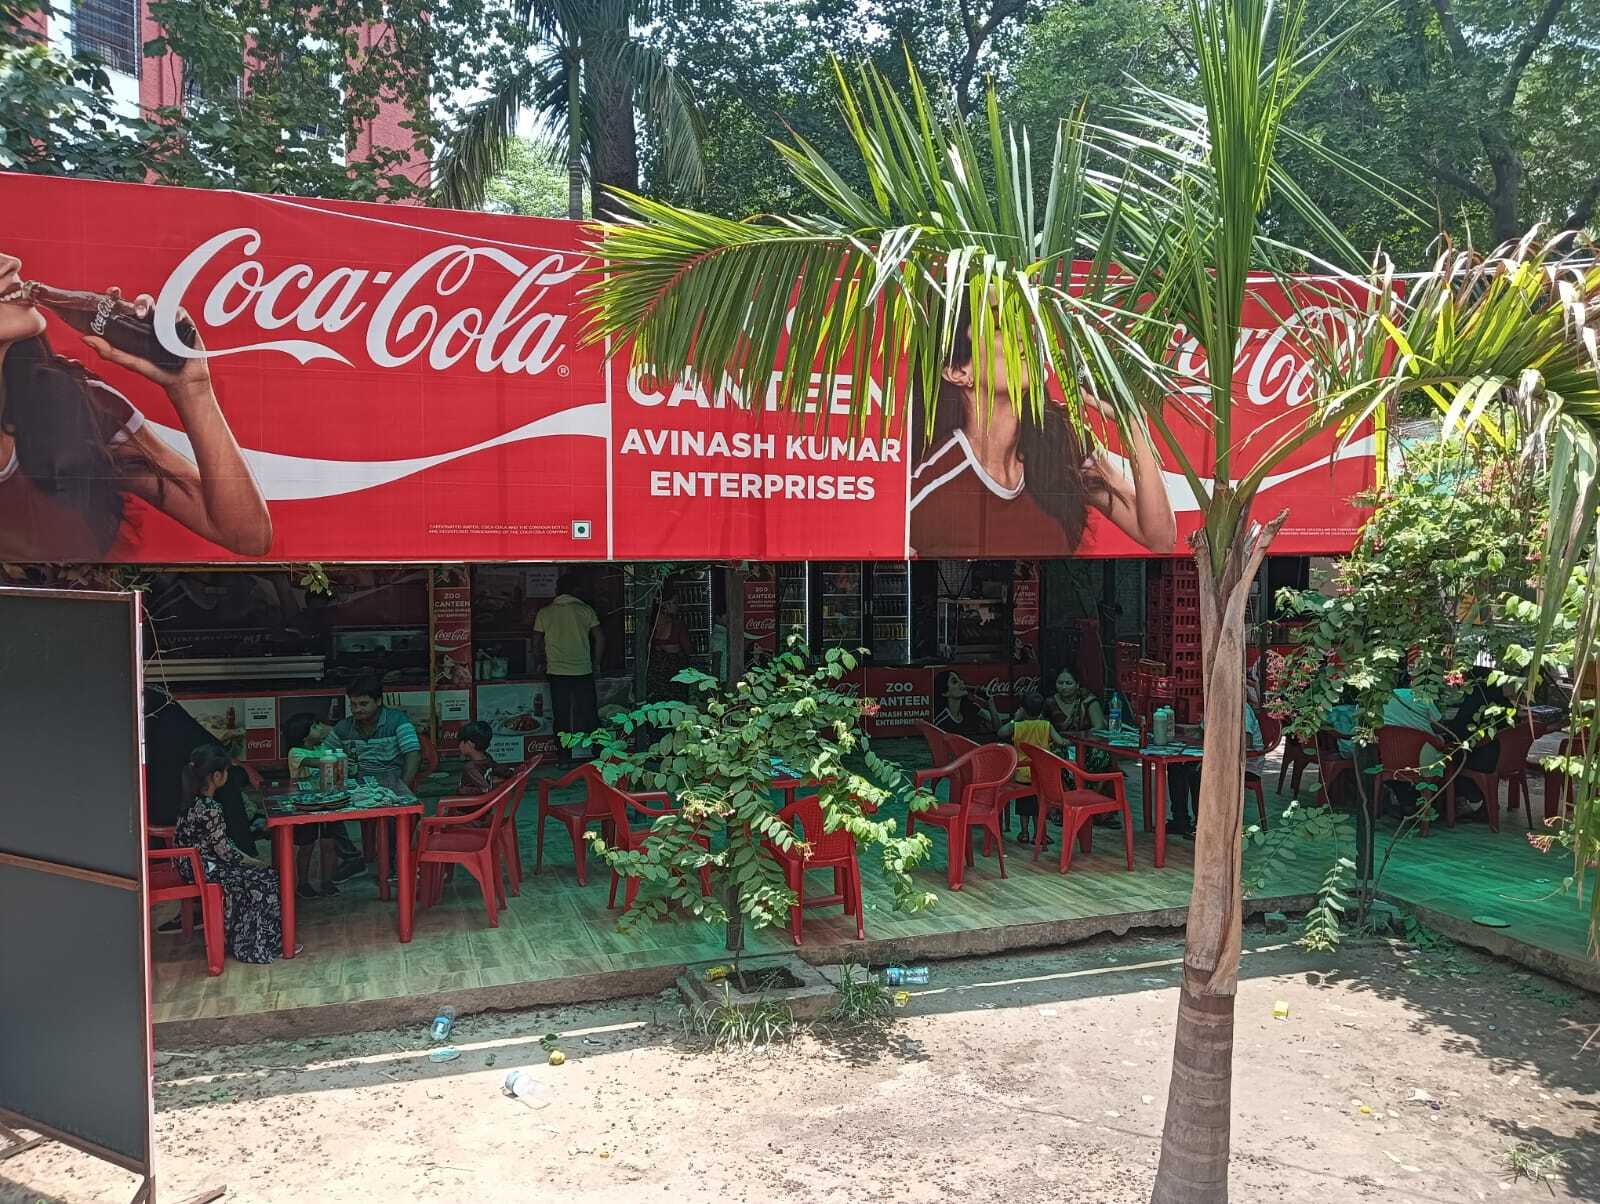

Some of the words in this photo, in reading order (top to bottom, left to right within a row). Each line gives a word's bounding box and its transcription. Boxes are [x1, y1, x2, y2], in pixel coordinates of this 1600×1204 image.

[153, 227, 589, 376] Coca-Cola
[620, 428, 775, 459] AVINASH
[785, 434, 901, 462] KUMAR
[650, 471, 875, 501] ENTERPRISES
[878, 695, 930, 706] ANTEEN
[886, 682, 913, 693] ZOO
